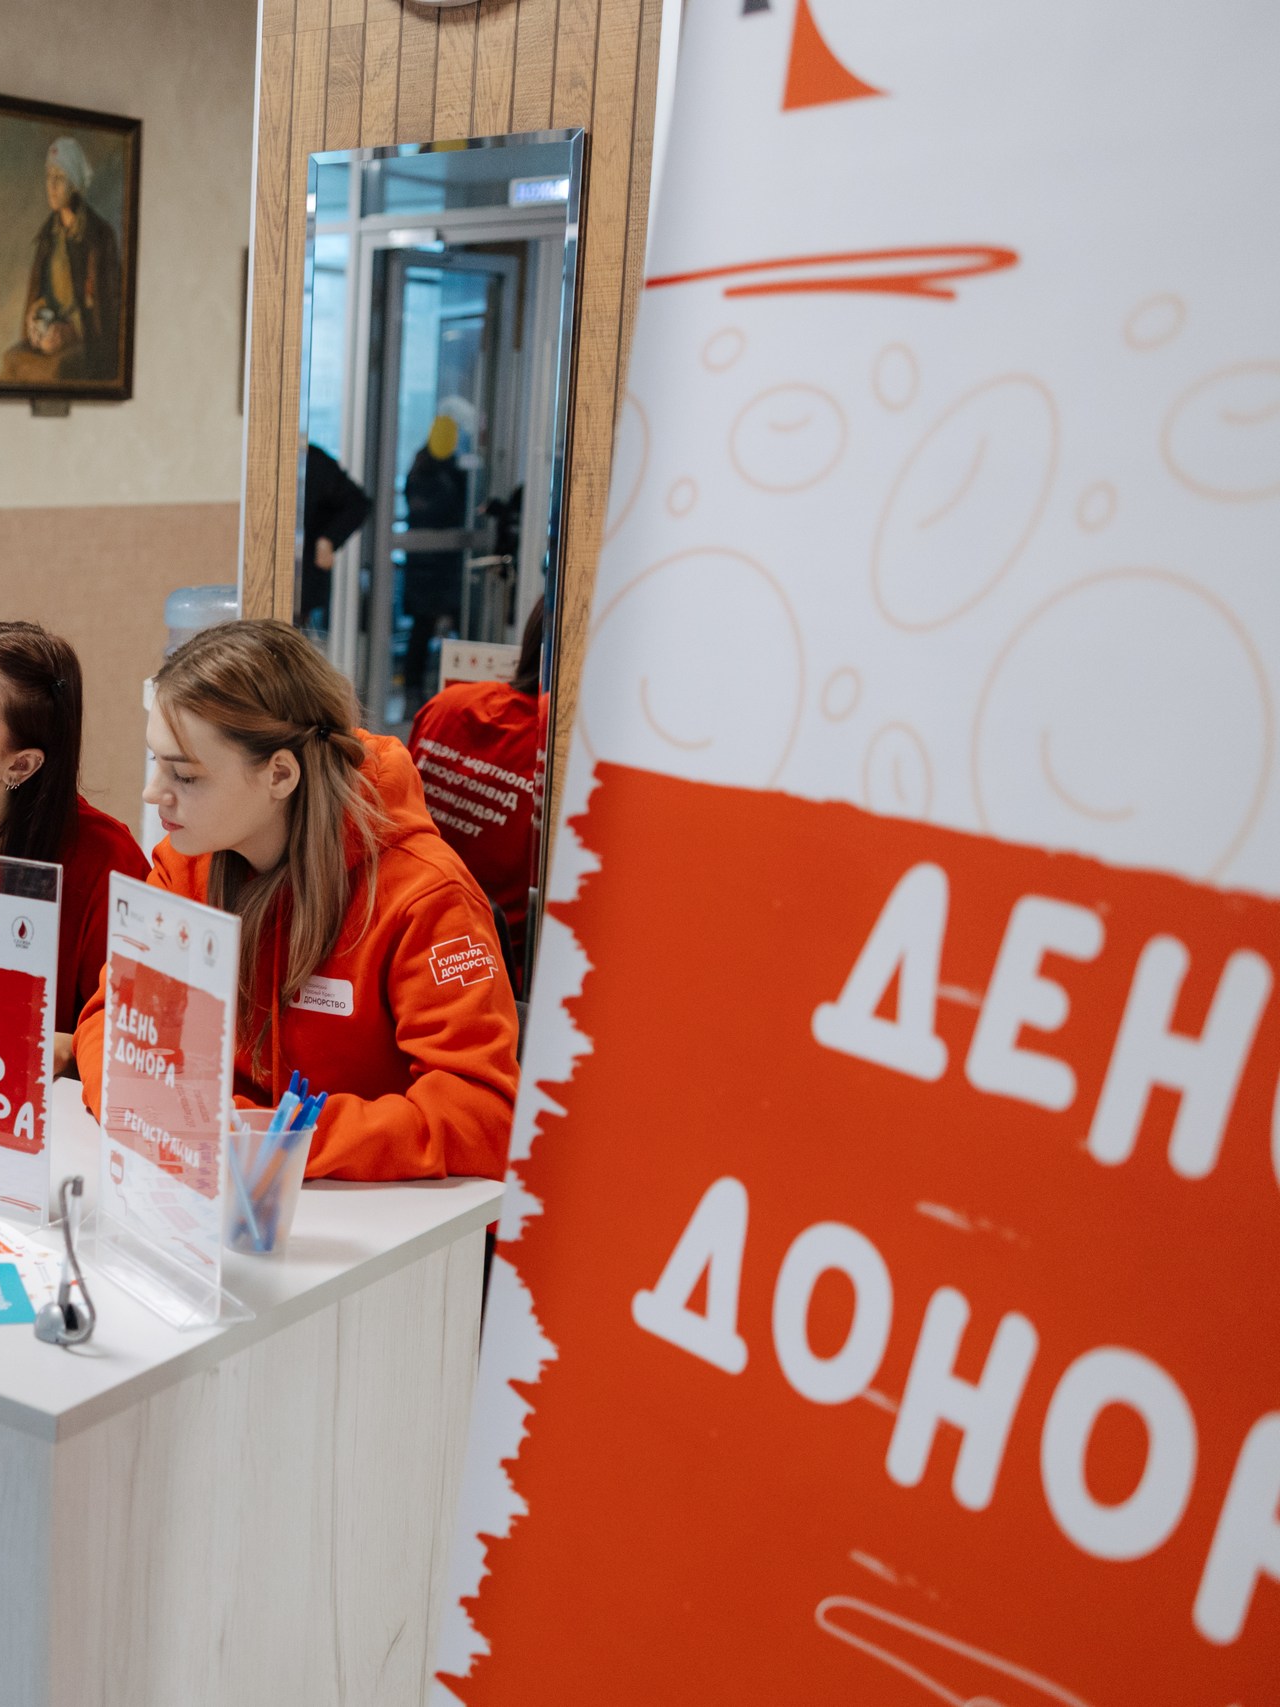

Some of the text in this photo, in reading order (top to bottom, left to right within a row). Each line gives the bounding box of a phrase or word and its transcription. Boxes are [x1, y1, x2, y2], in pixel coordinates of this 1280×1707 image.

[437, 948, 483, 967] КУЛЬТУРА
[441, 956, 493, 979] ДОНОРСТВ
[116, 1002, 158, 1046] ДЕНЬ
[304, 996, 346, 1009] ДОНОРСТВО
[811, 862, 1280, 1193] ДЕН
[115, 1037, 175, 1089] ДОНОРА
[124, 1109, 199, 1168] РЕГИСТРАЦИЯ
